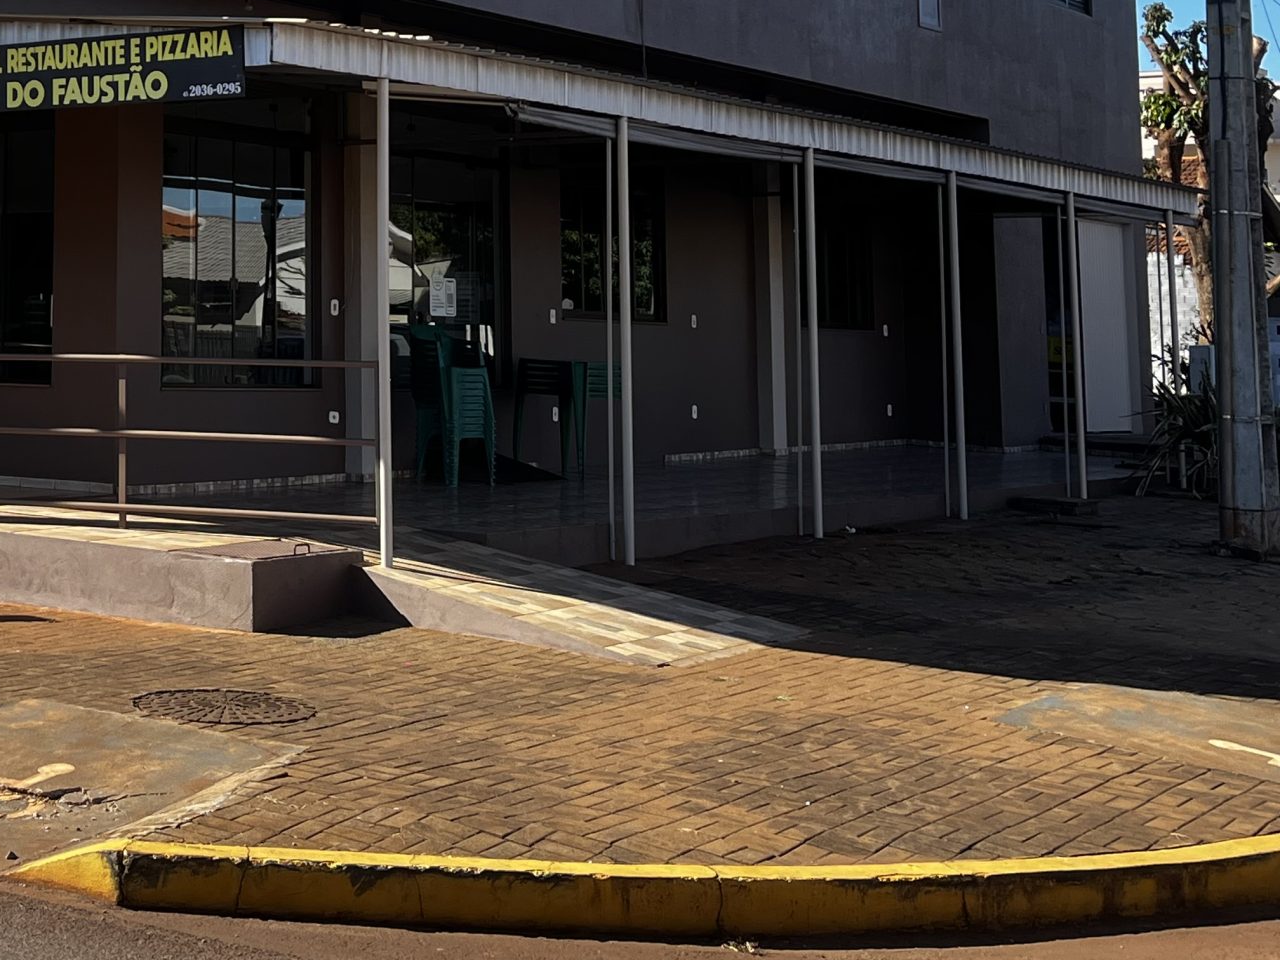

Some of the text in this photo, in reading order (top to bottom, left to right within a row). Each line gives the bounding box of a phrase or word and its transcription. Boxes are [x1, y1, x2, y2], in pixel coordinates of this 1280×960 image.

[7, 39, 125, 73] RESTAURANTE
[130, 37, 141, 64] E
[145, 29, 234, 62] PIZZARIA
[6, 64, 168, 109] DO FAUSTÃO
[189, 82, 242, 97] 2036-0295
